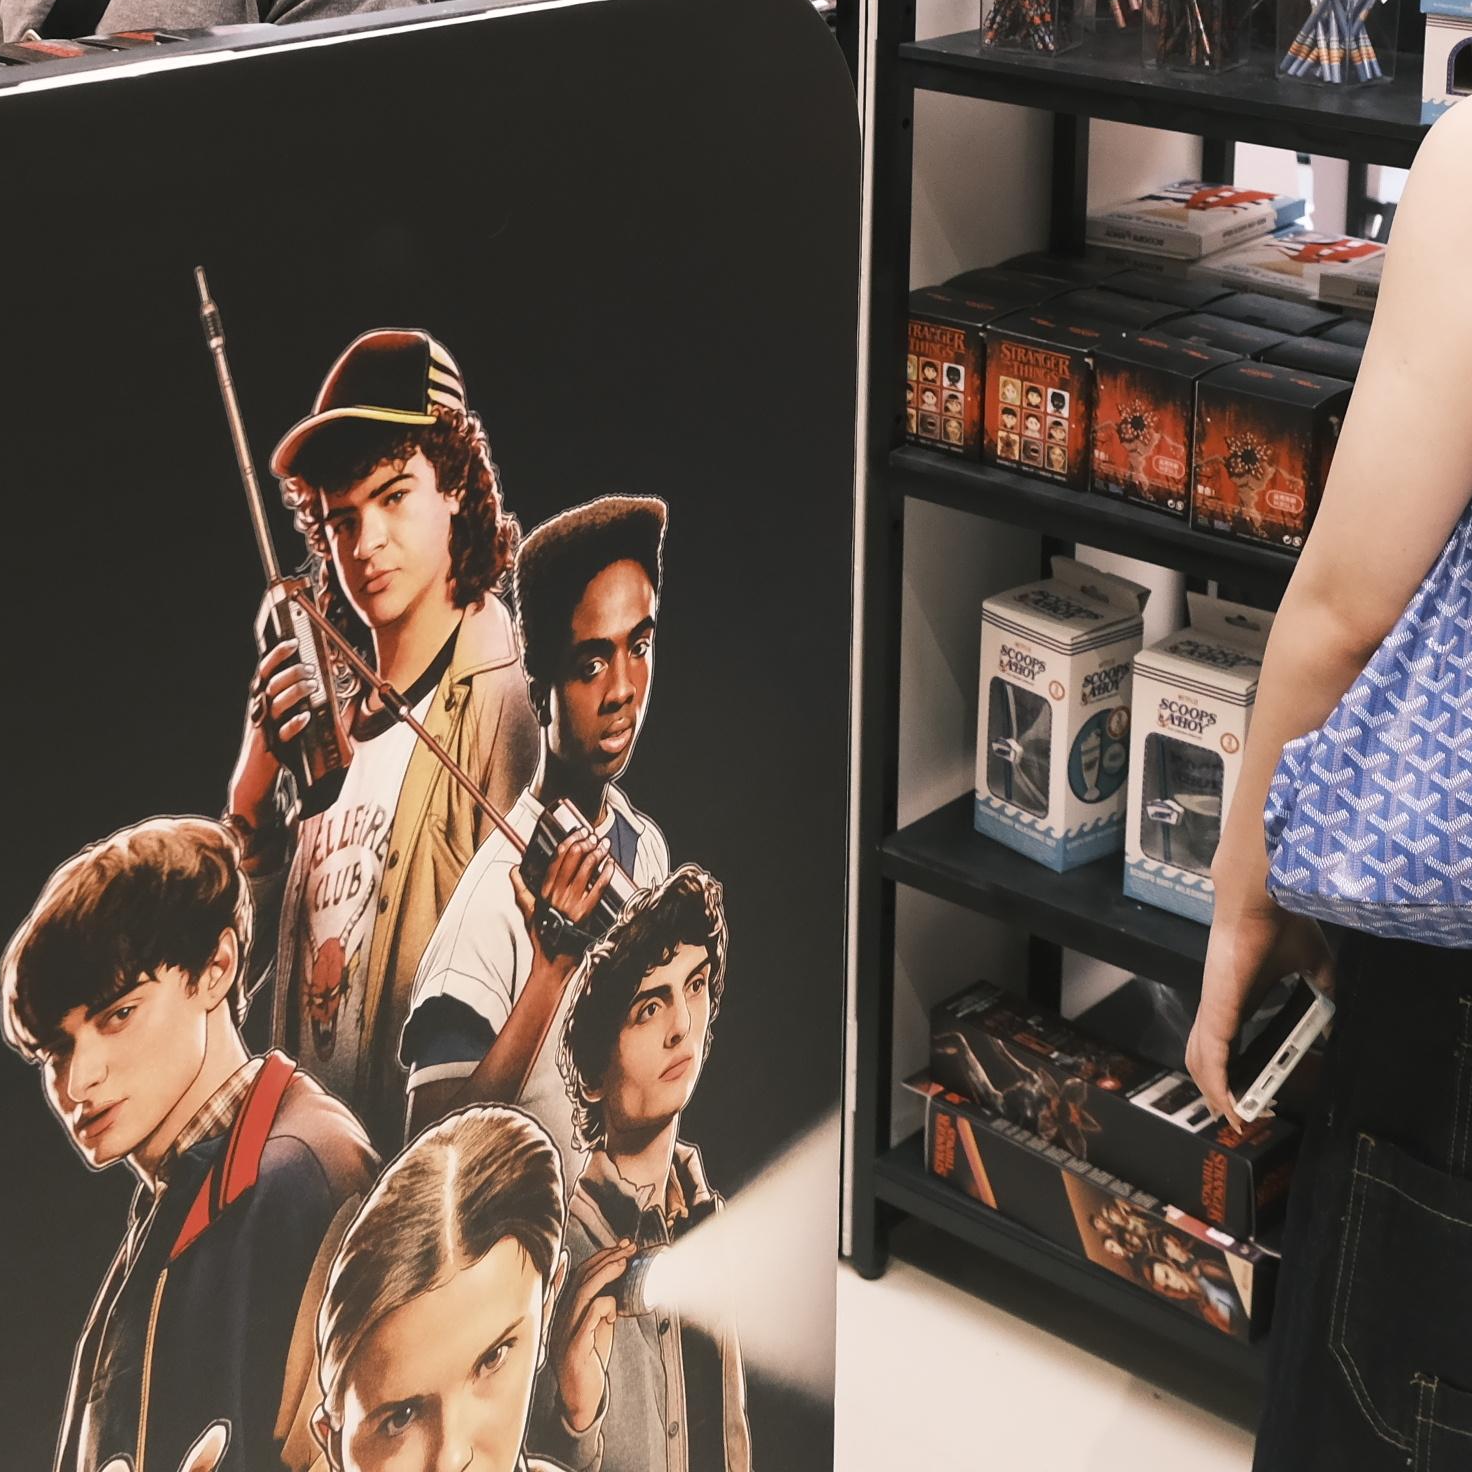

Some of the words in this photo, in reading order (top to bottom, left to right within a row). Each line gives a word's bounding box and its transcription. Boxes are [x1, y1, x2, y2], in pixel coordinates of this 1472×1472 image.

[908, 321, 966, 354] TRANGER
[1001, 342, 1070, 377] STRANGER
[1012, 362, 1059, 383] THINGS
[1000, 643, 1046, 673] SCOOPS
[1006, 659, 1041, 681] AHOY
[1084, 663, 1130, 689] SCOOPS
[1088, 676, 1125, 699] AHOY
[1160, 697, 1217, 726] SCOOPS
[1166, 714, 1211, 735] AHOY
[309, 804, 391, 869] ELLFIRE
[315, 862, 362, 913] CLUB
